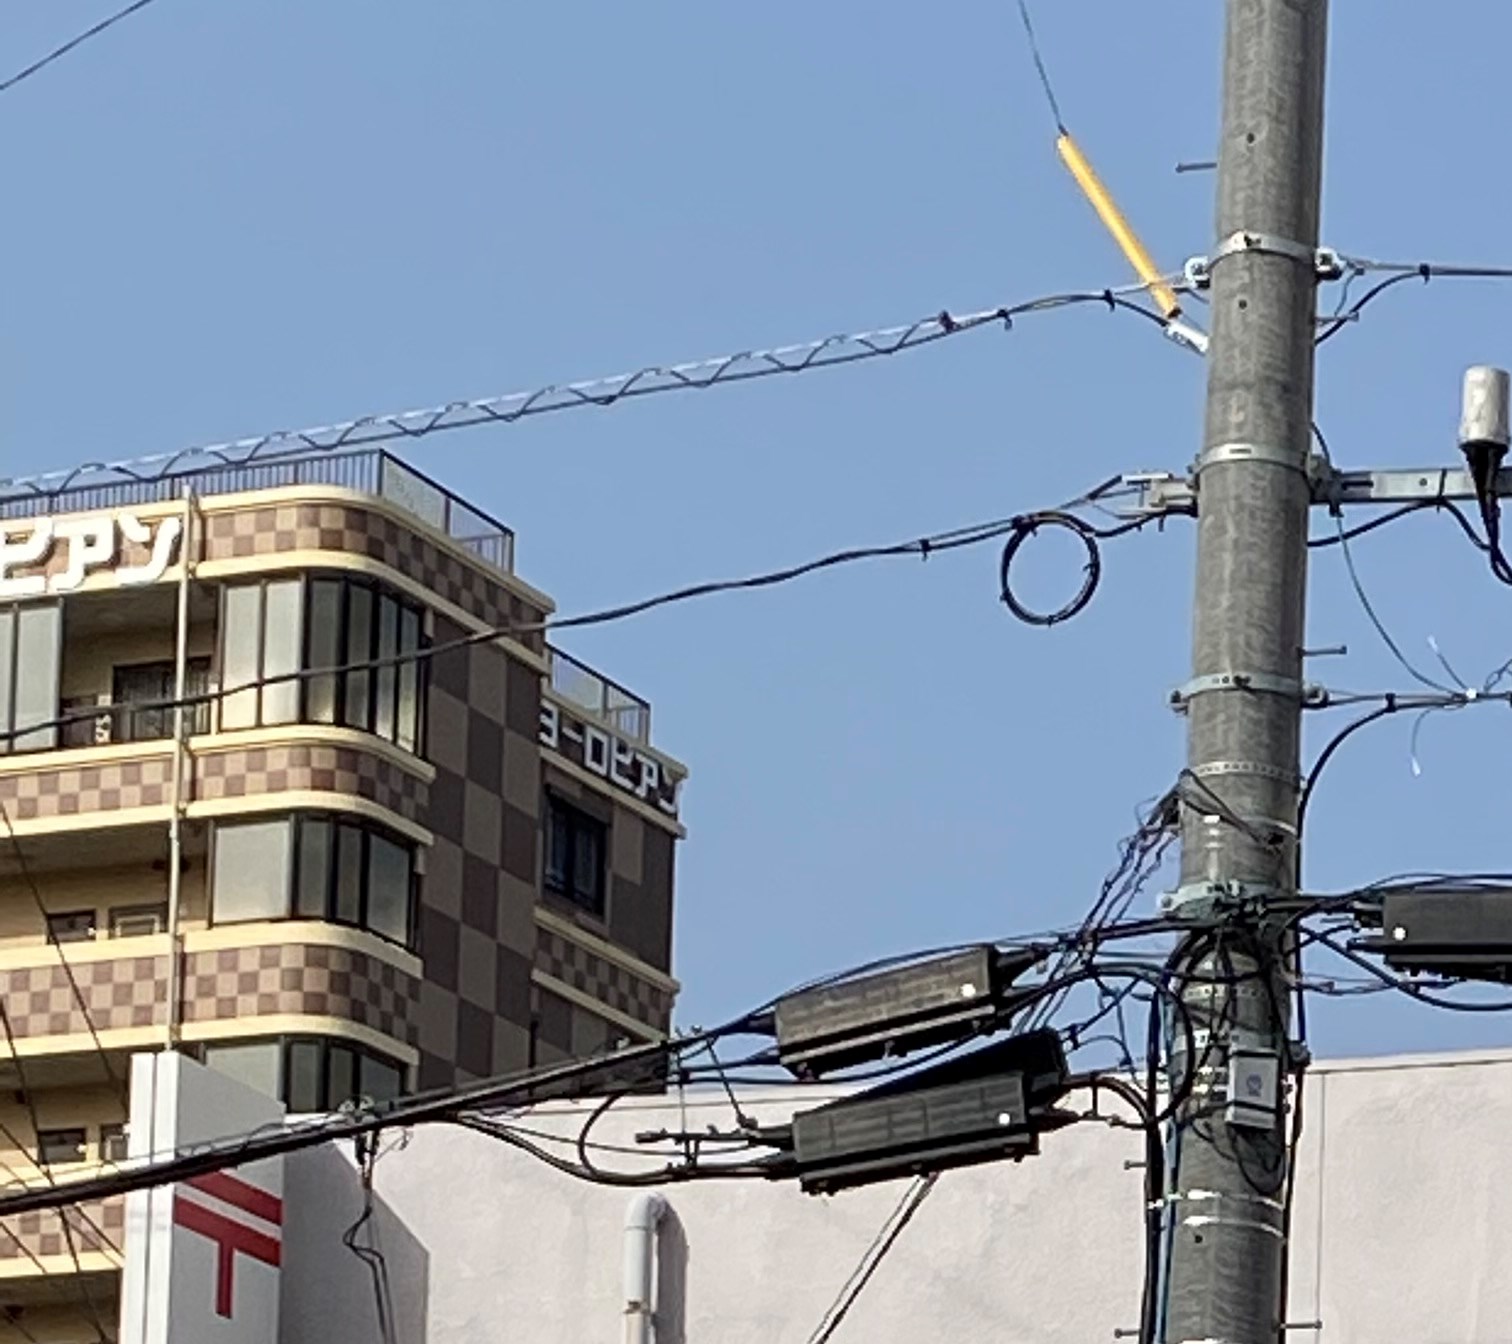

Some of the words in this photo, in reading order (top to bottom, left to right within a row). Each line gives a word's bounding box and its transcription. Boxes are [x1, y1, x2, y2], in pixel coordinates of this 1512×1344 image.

[539, 697, 680, 814] ヨーロピアン
